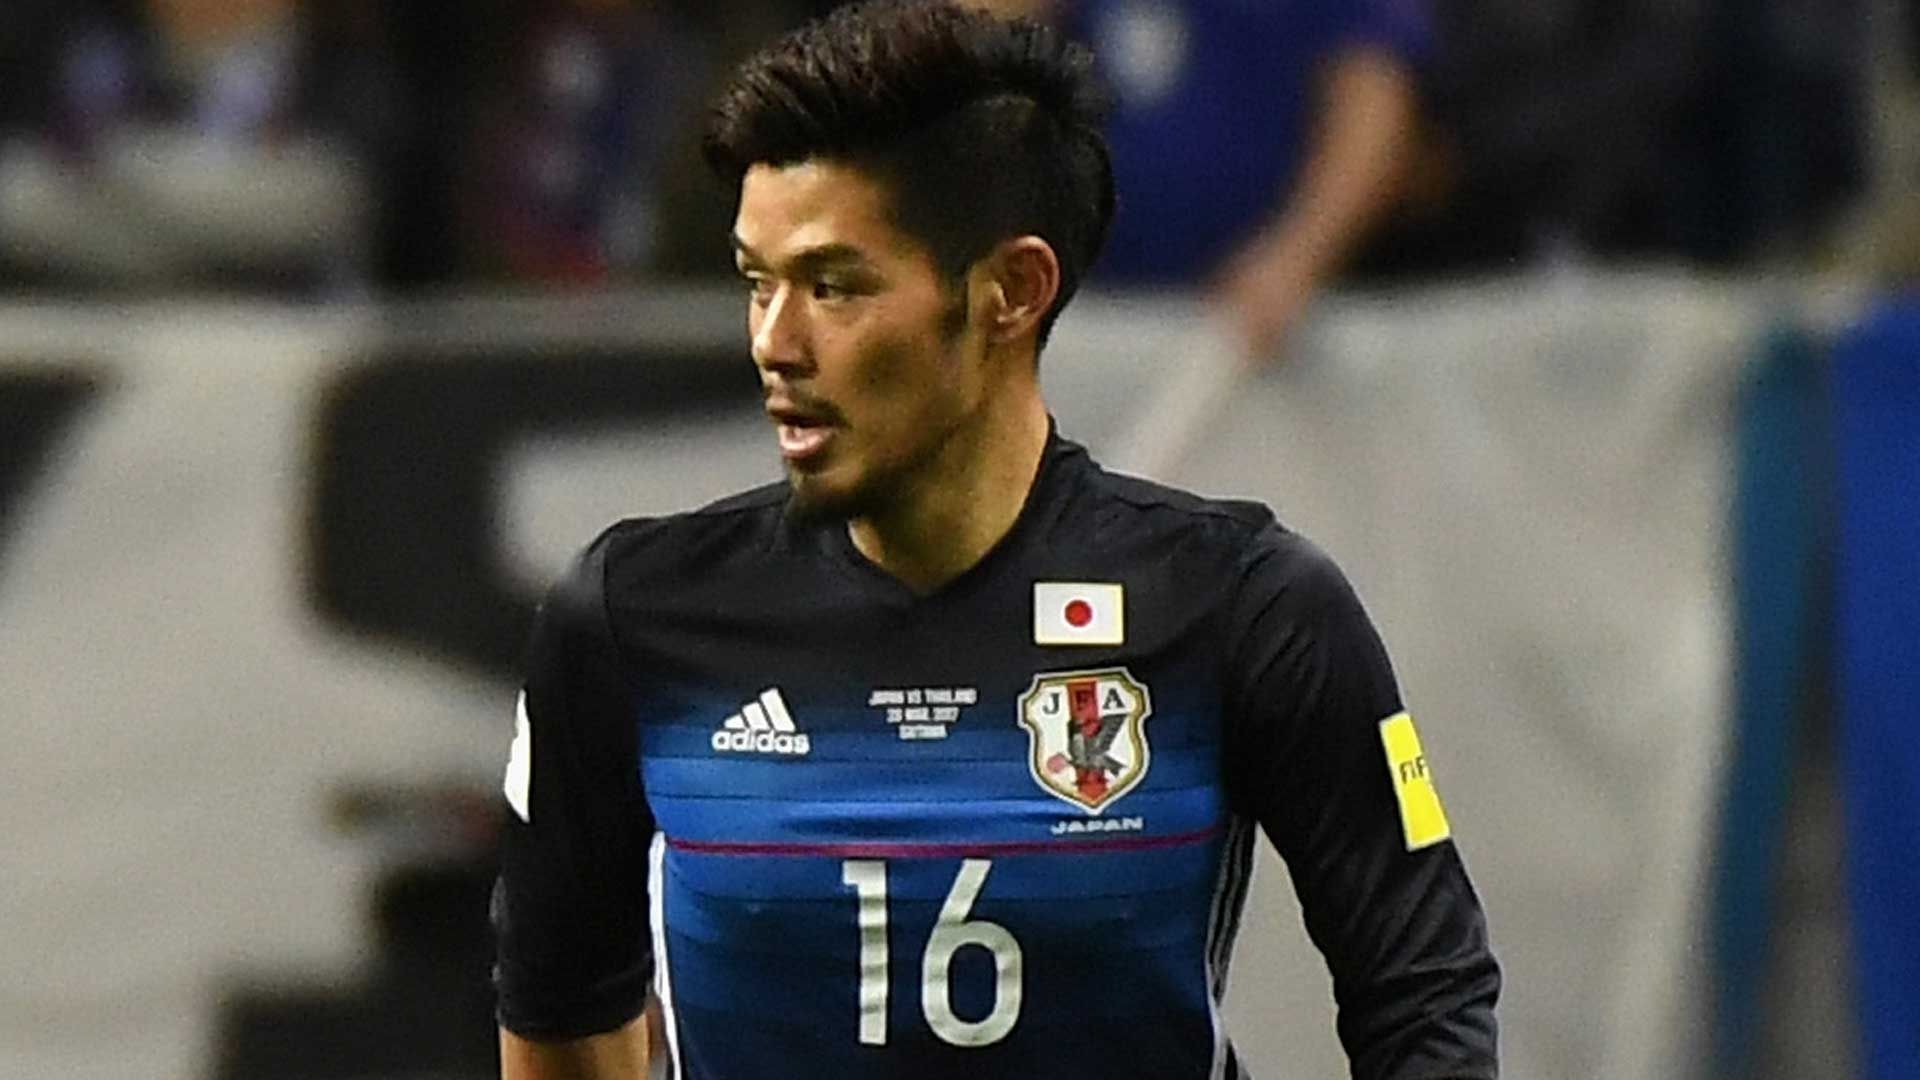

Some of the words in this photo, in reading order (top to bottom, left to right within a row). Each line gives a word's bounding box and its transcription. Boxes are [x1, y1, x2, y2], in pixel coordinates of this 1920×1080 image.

[711, 726, 810, 755] adidas
[1050, 816, 1144, 835] JAPAN
[843, 859, 1022, 1047] 16
